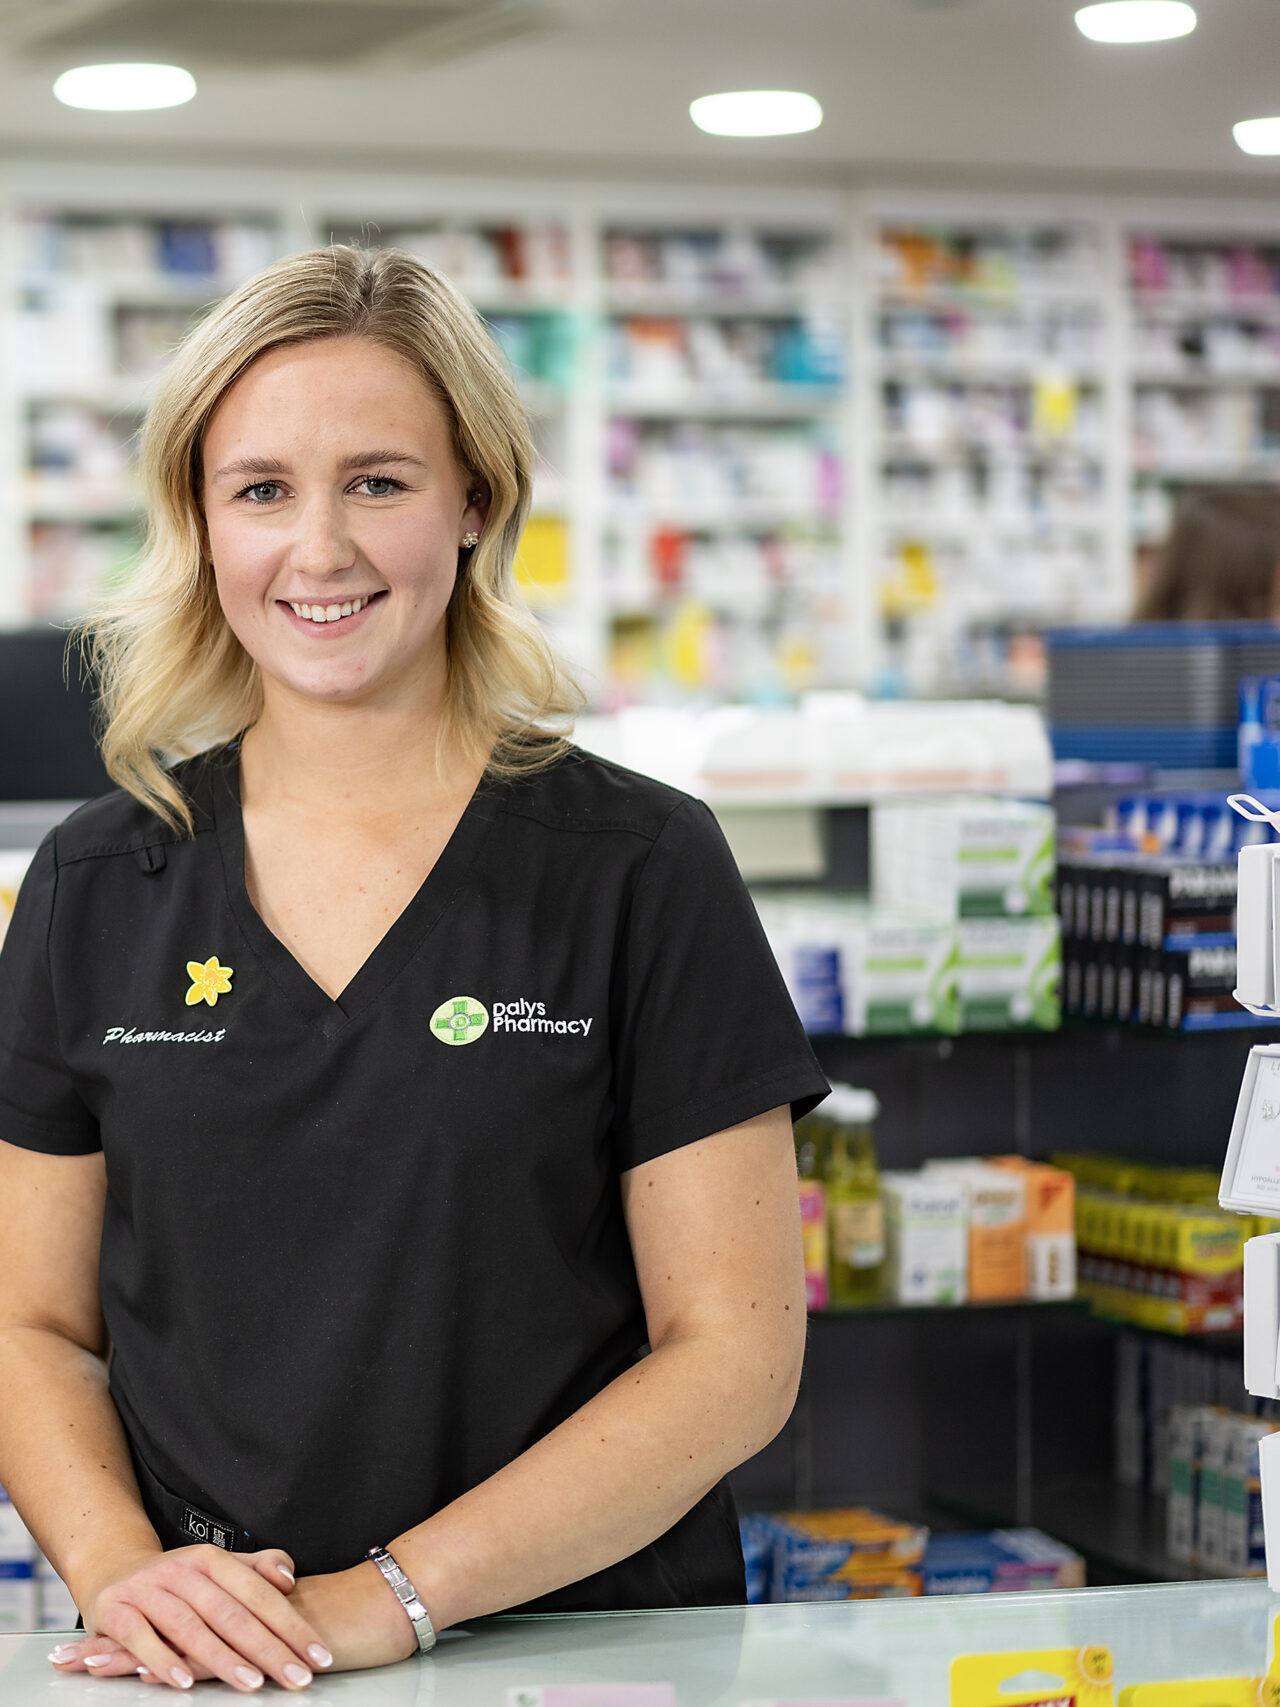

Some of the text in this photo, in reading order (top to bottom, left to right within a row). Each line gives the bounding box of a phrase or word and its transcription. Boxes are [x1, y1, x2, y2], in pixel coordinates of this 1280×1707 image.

[492, 997, 546, 1018] Dalys
[493, 1014, 593, 1036] Pharmacy
[102, 1027, 226, 1045] Pharmacist
[188, 1514, 209, 1540] koi
